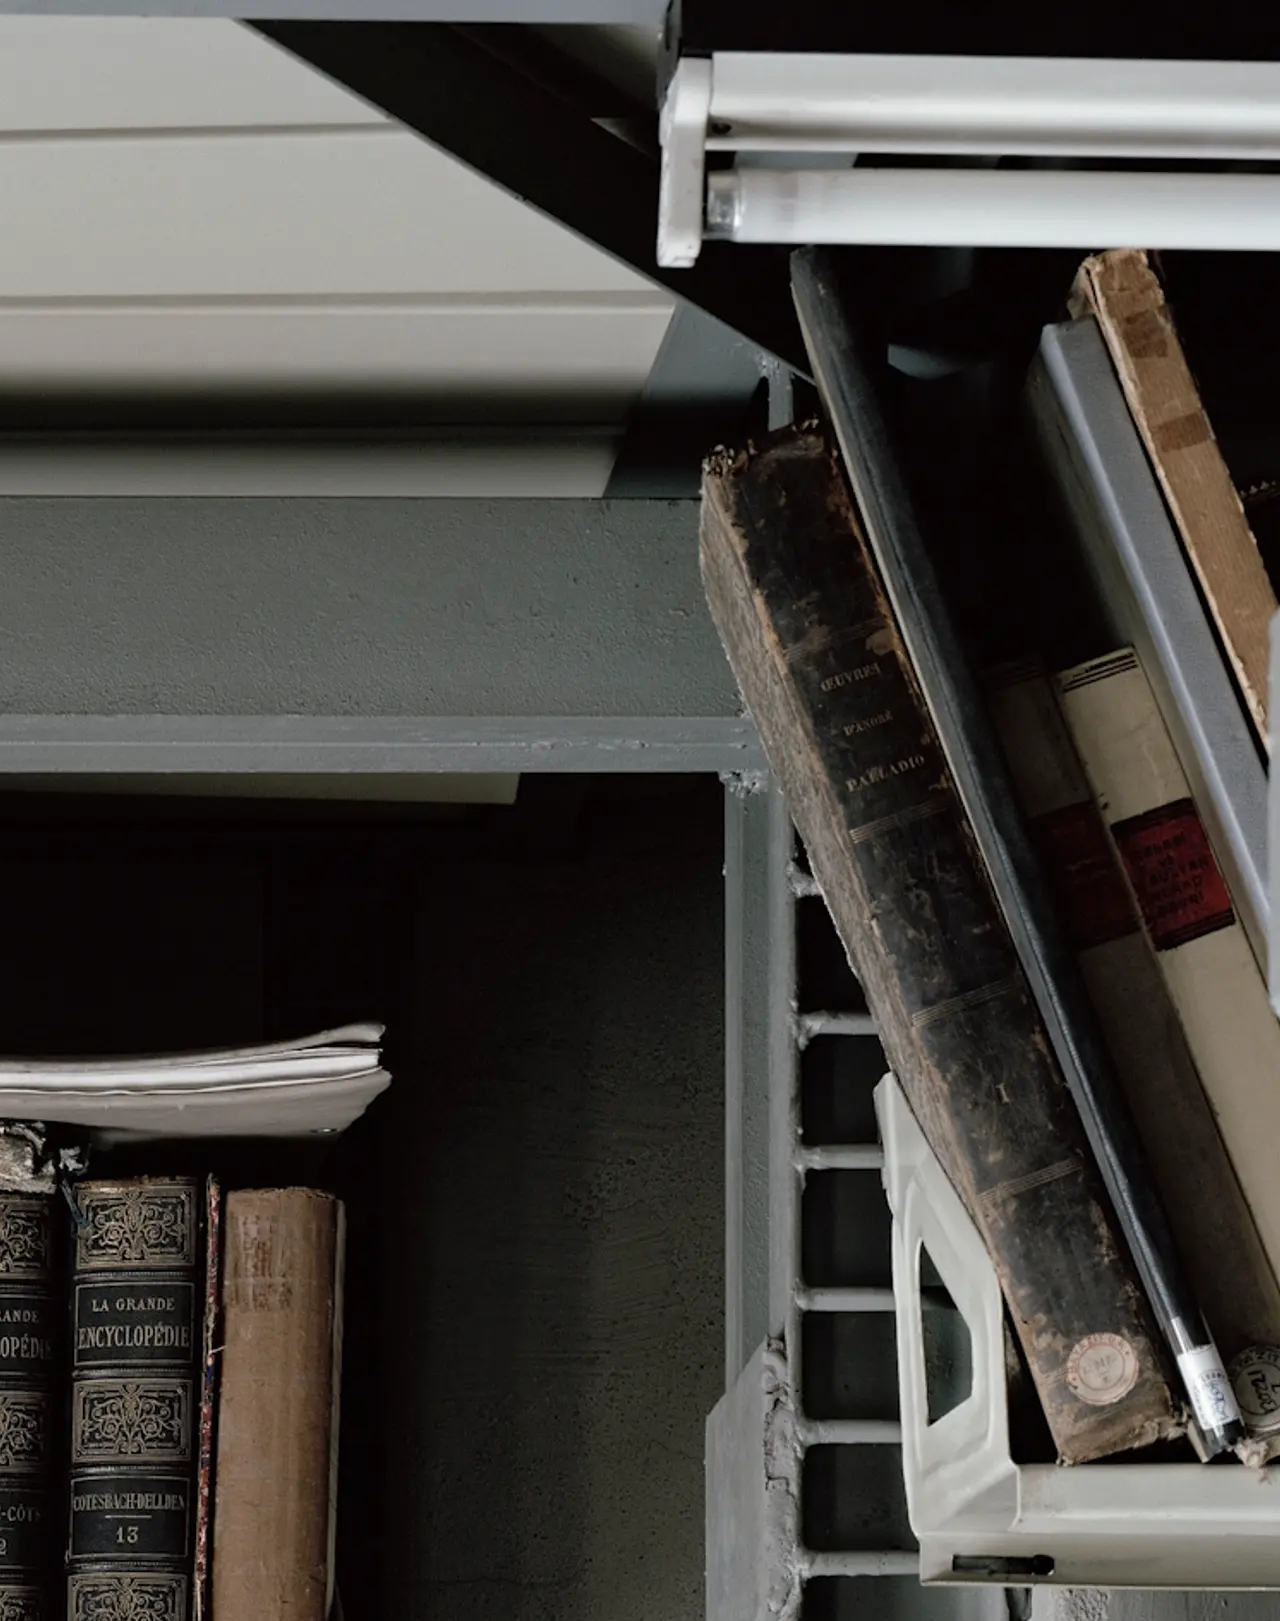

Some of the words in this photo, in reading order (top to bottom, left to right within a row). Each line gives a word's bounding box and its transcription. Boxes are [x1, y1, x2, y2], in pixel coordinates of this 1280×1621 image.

[92, 1298, 109, 1313] LA
[116, 1297, 175, 1311] GRANDE
[78, 1322, 190, 1349] ENCYCLOPÉDIE
[116, 1526, 139, 1544] 13
